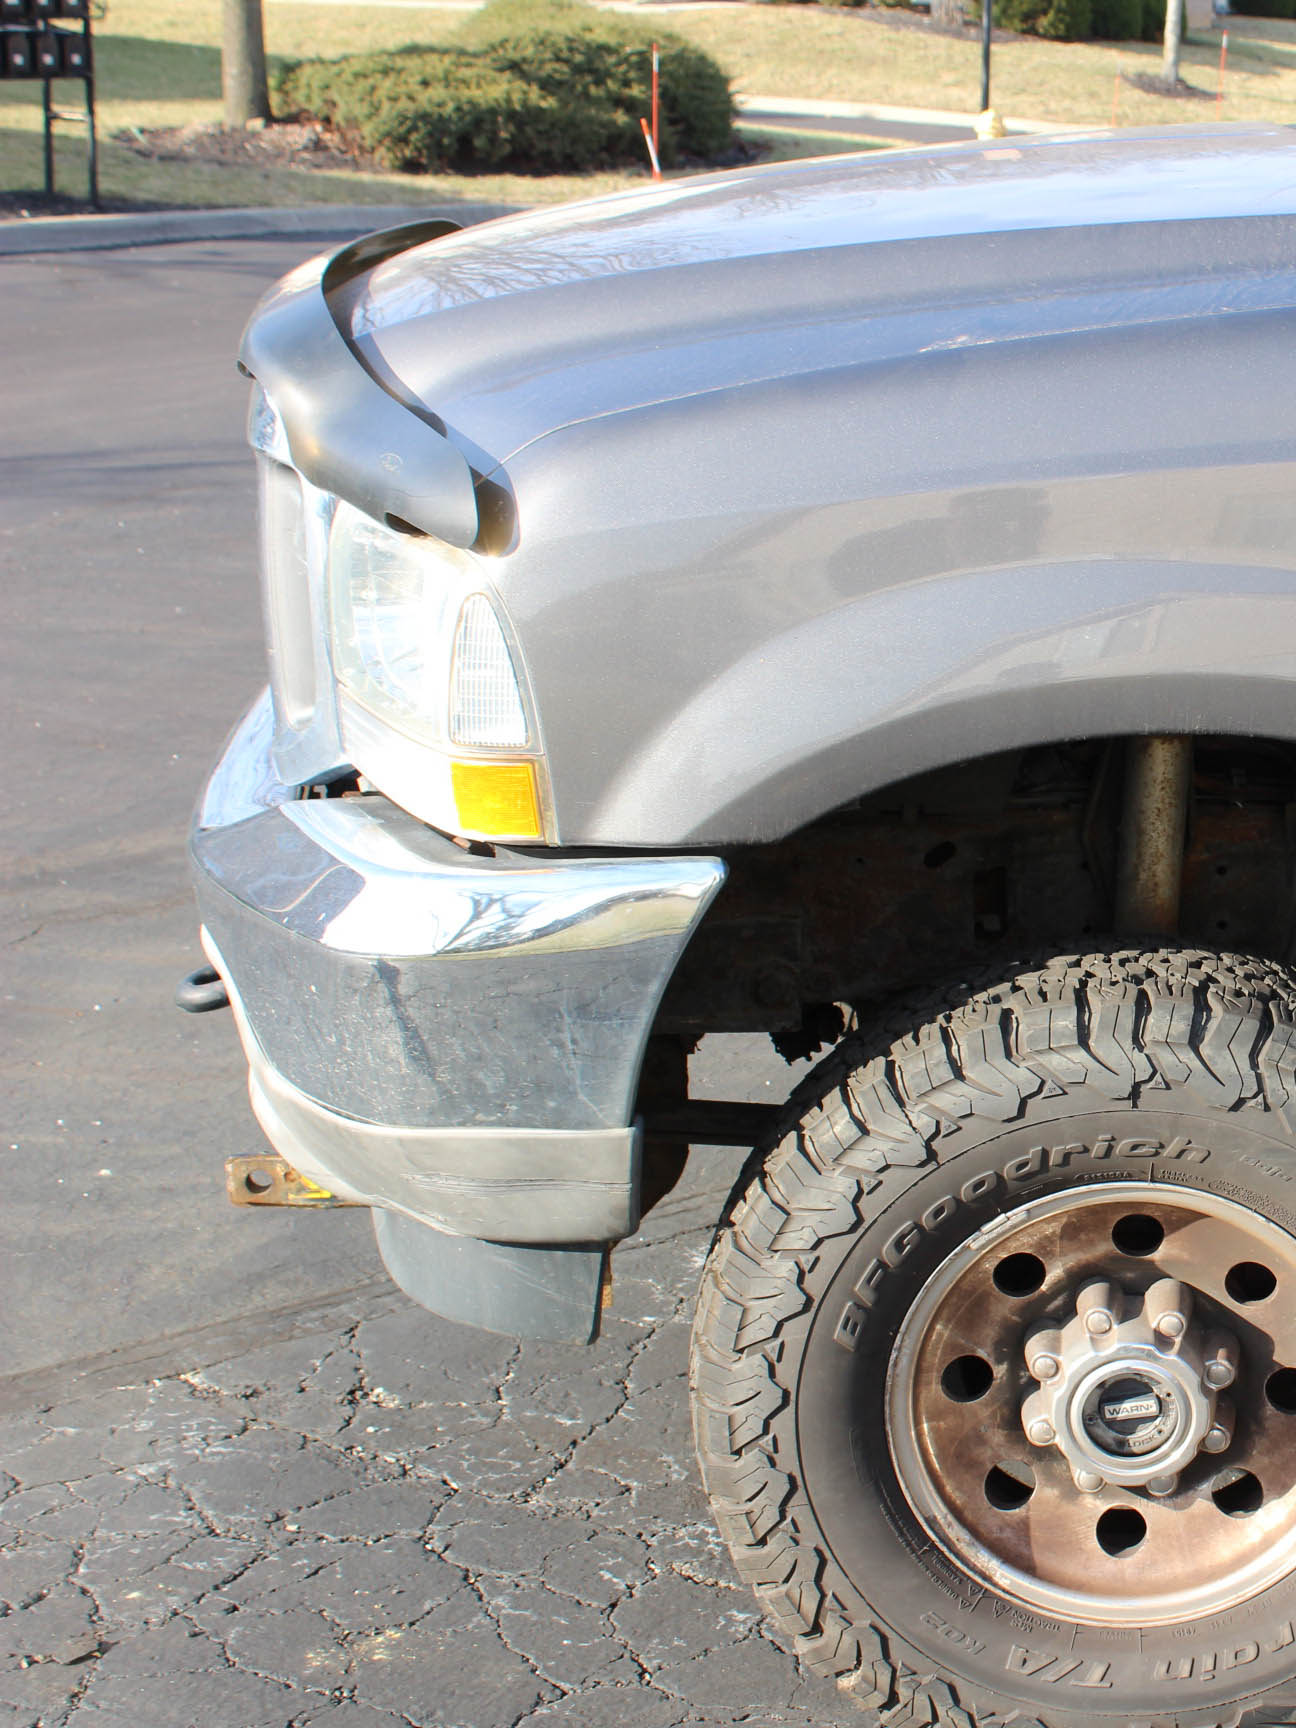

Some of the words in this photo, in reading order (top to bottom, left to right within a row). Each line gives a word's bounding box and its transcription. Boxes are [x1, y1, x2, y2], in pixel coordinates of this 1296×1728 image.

[832, 1133, 1212, 1353] BFGoodrich
[1107, 1403, 1154, 1417] WARN
[1003, 1643, 1114, 1690] T/A
